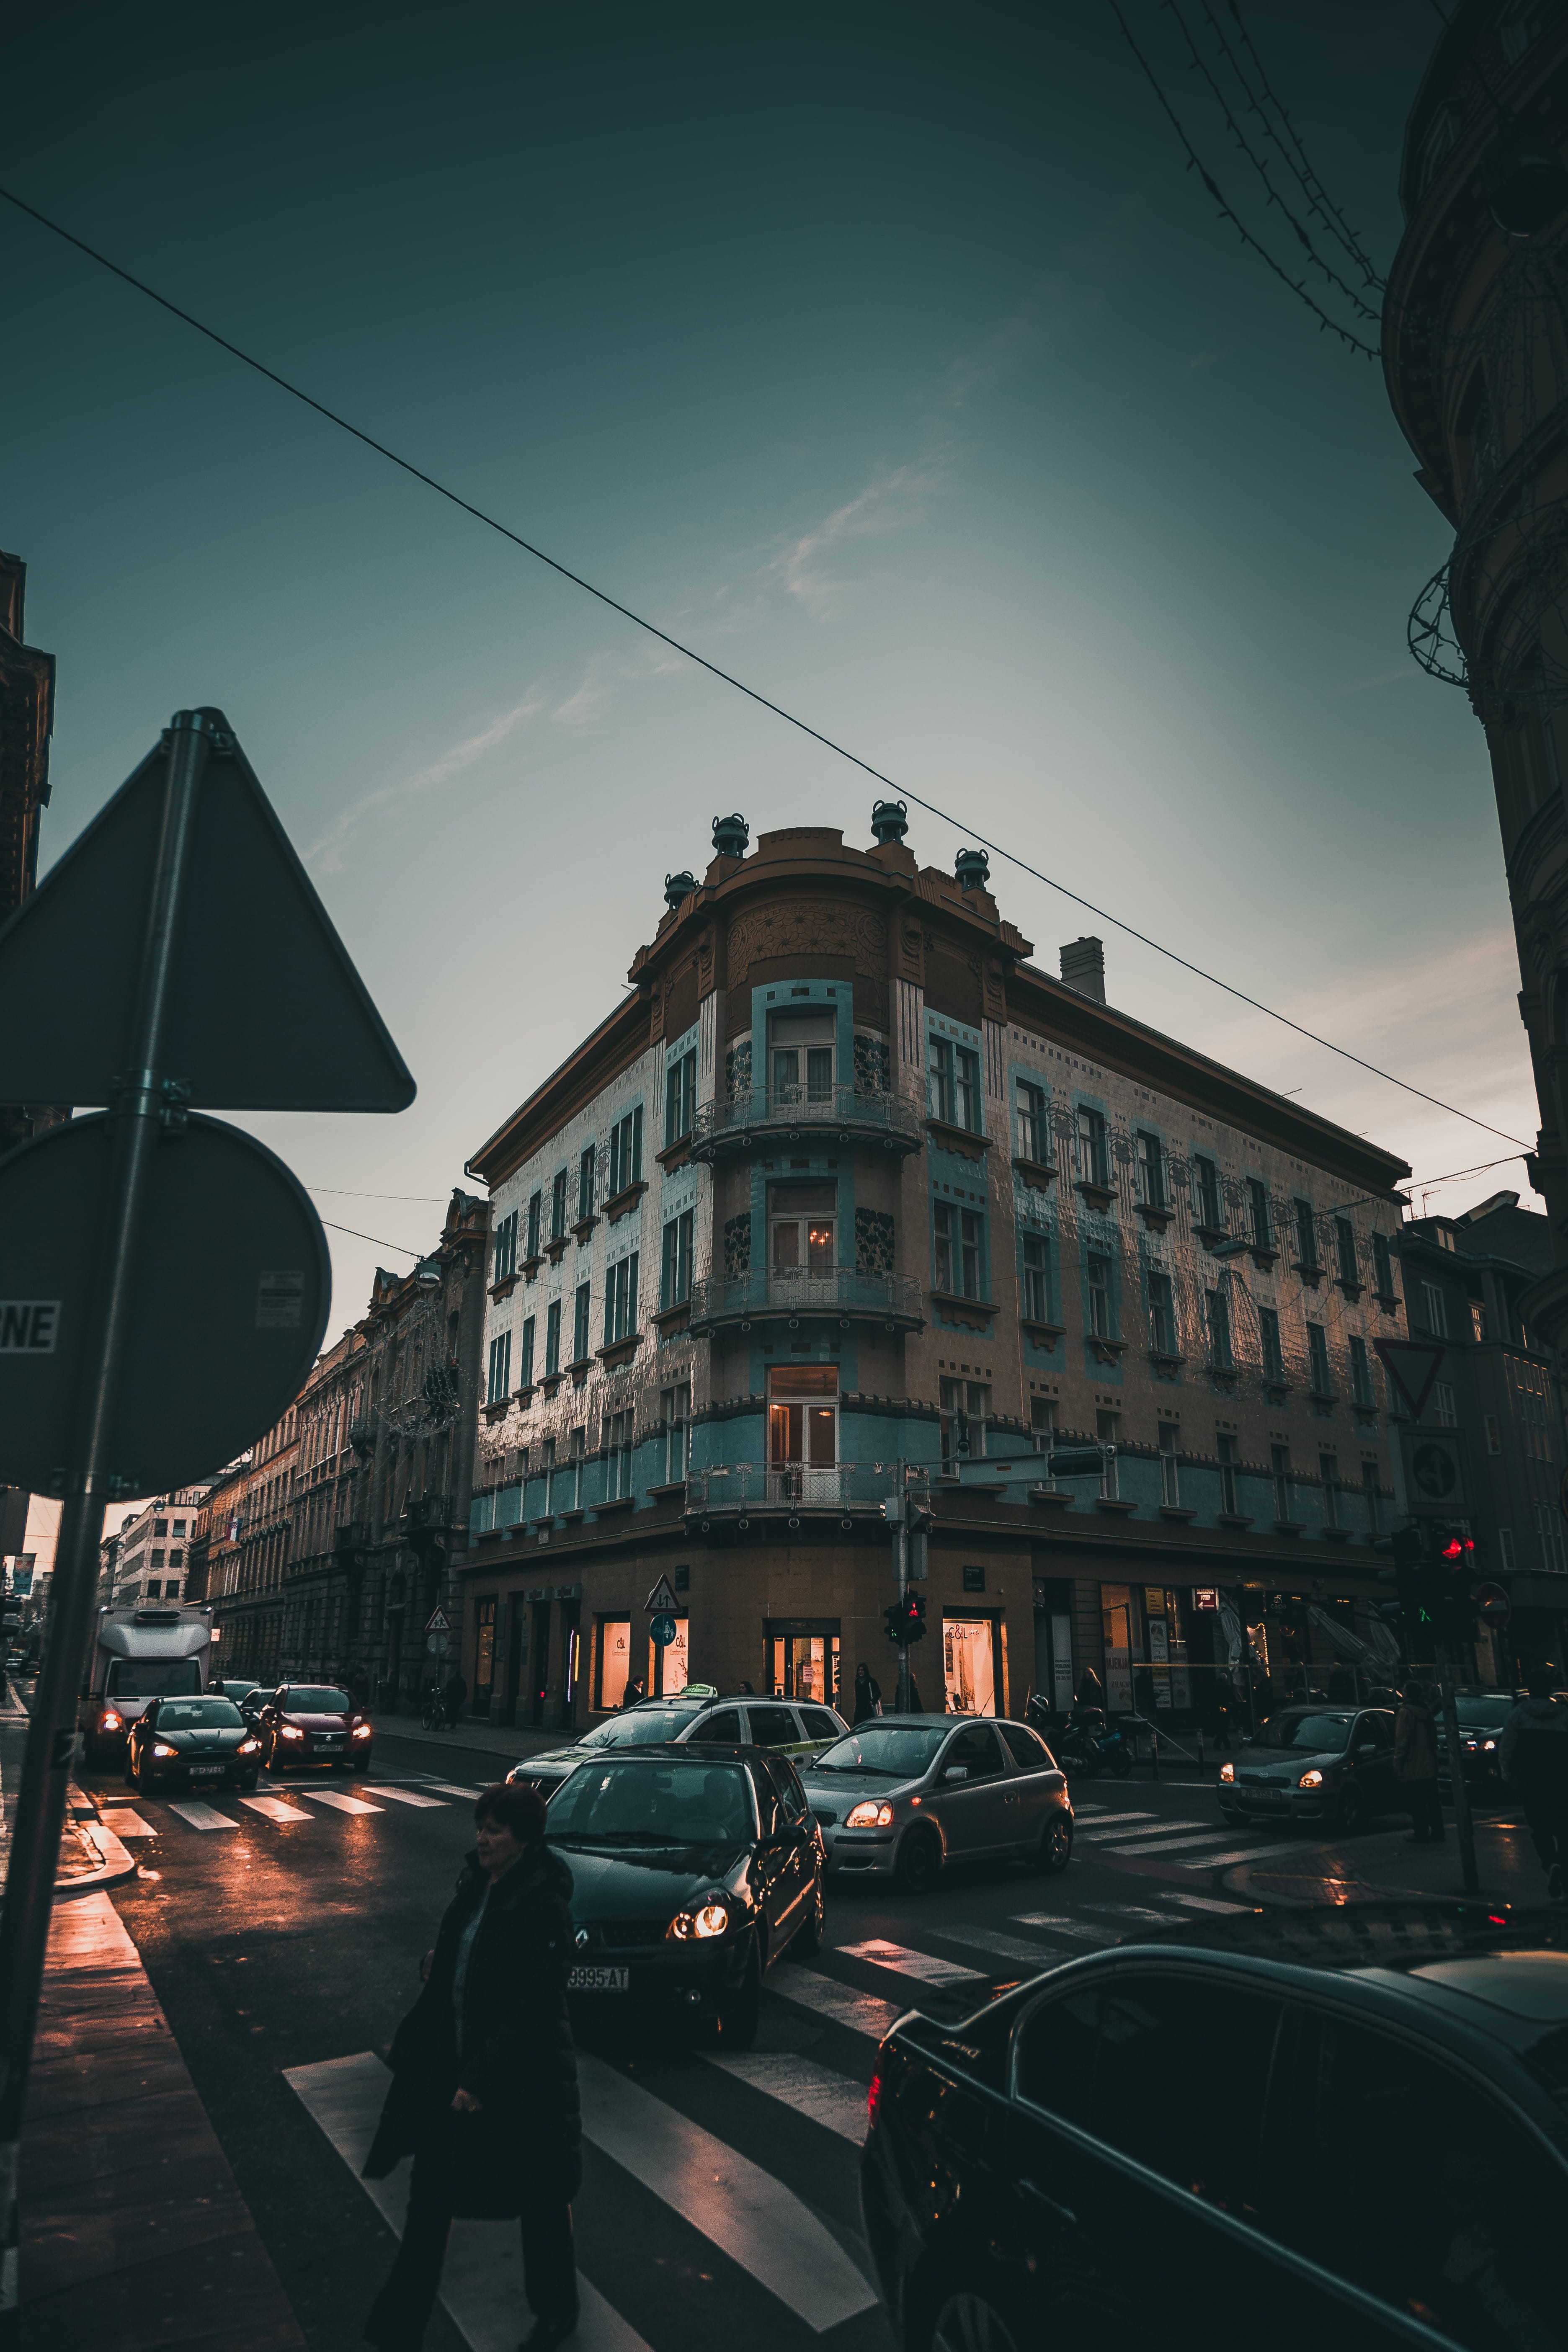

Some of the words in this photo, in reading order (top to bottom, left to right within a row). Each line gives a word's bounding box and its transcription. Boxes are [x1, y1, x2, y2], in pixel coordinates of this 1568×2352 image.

[0, 1306, 55, 1347] NE
[617, 1637, 625, 1649] C&L
[676, 1635, 686, 1648] C&L
